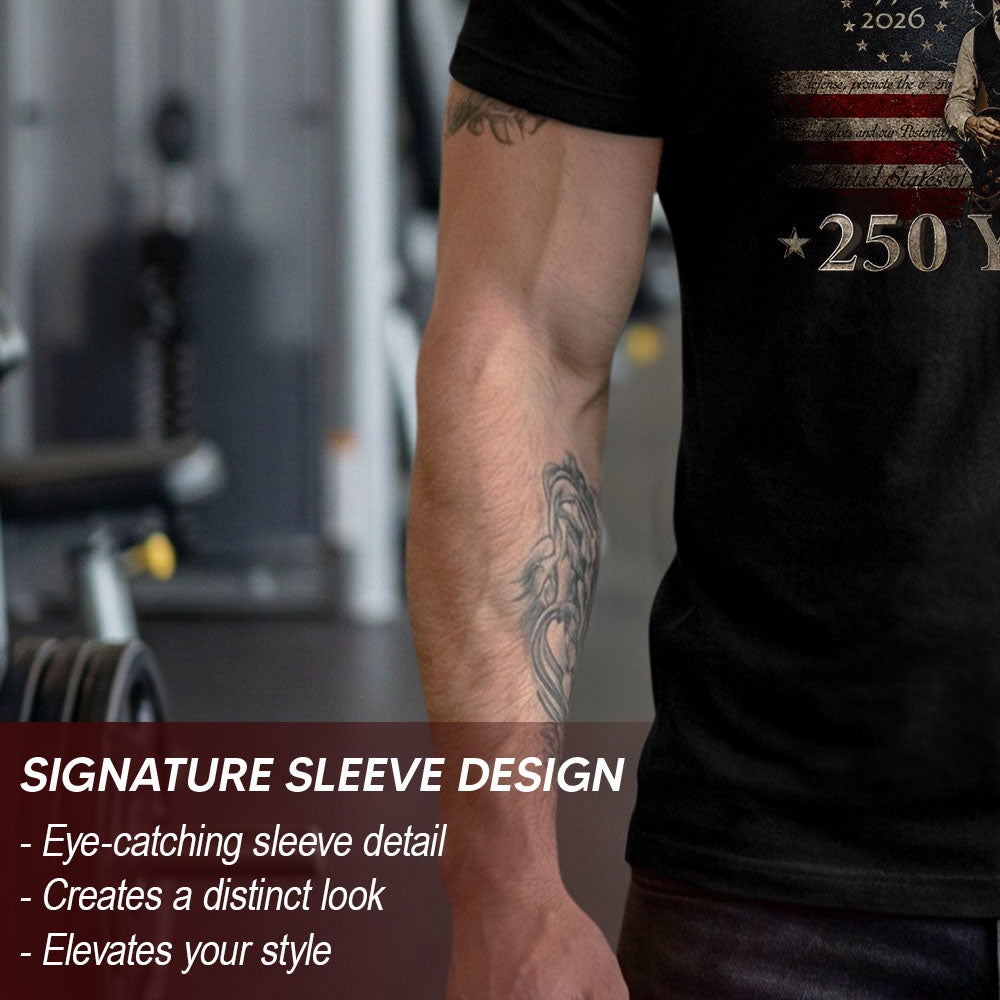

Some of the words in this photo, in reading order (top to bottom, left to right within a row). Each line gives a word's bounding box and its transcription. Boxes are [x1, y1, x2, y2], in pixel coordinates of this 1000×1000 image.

[861, 6, 926, 29] 2026
[849, 78, 893, 94] promote
[896, 75, 914, 90] the
[884, 166, 942, 187] States
[818, 213, 948, 273] 250
